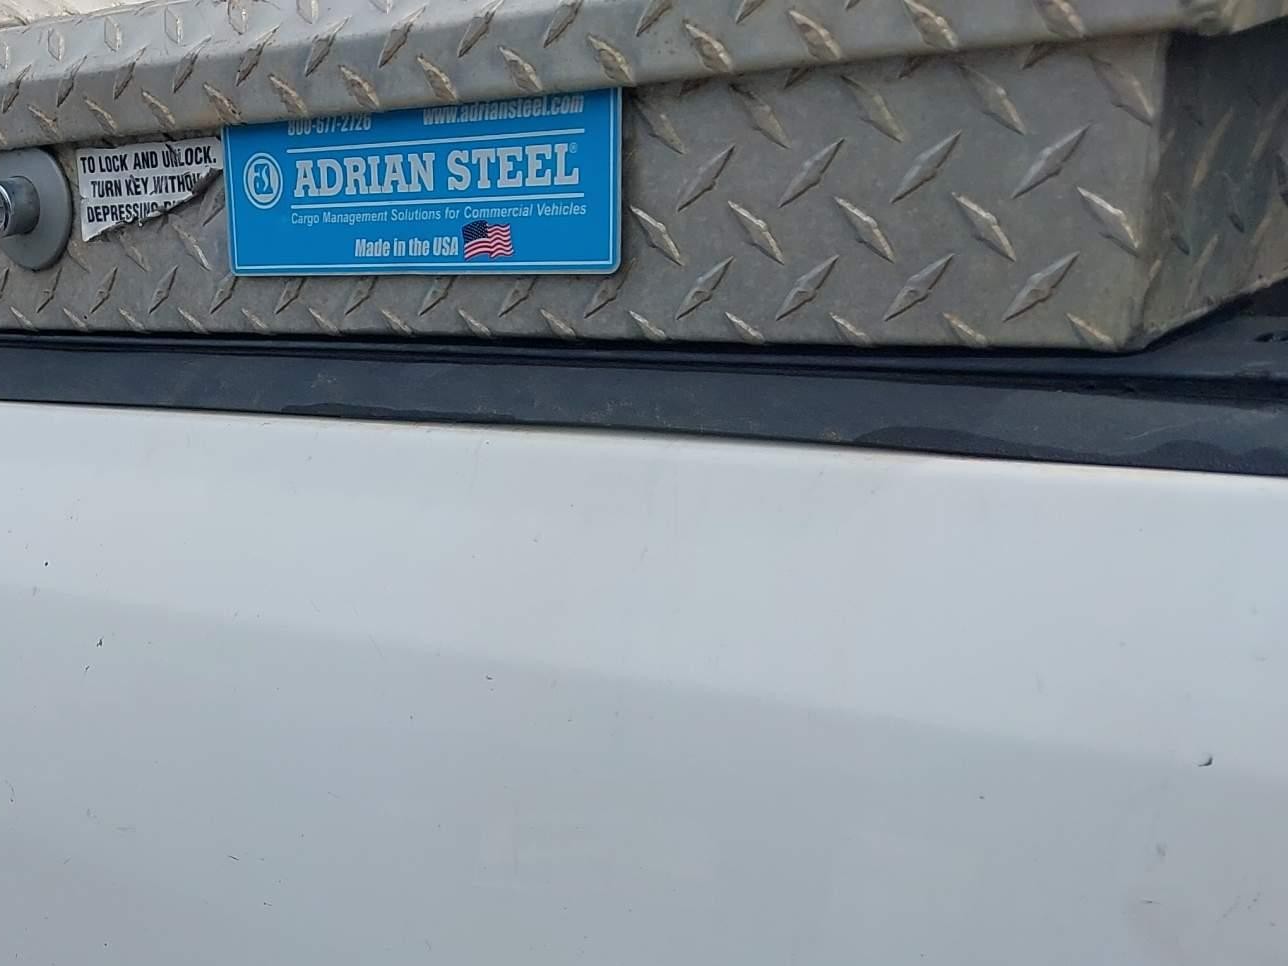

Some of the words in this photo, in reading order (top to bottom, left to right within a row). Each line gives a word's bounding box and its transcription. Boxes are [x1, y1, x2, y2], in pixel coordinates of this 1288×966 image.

[423, 95, 585, 126] www.adriansteel.com
[80, 155, 96, 174] TO
[98, 153, 129, 173] LOCK
[133, 150, 159, 170] AND
[90, 178, 123, 198] TURN
[125, 176, 150, 197] KEY
[152, 172, 201, 195] WITHOU
[294, 153, 436, 198] ADRIAN
[291, 212, 320, 227] Cargo
[322, 210, 388, 226] Management
[391, 208, 441, 222] Solutions
[445, 206, 460, 220] for
[464, 204, 533, 219] Commercial
[537, 203, 587, 217] Vehicles
[354, 238, 391, 257] Made
[393, 237, 406, 256] in
[408, 236, 430, 256] the
[433, 236, 459, 256] USA
